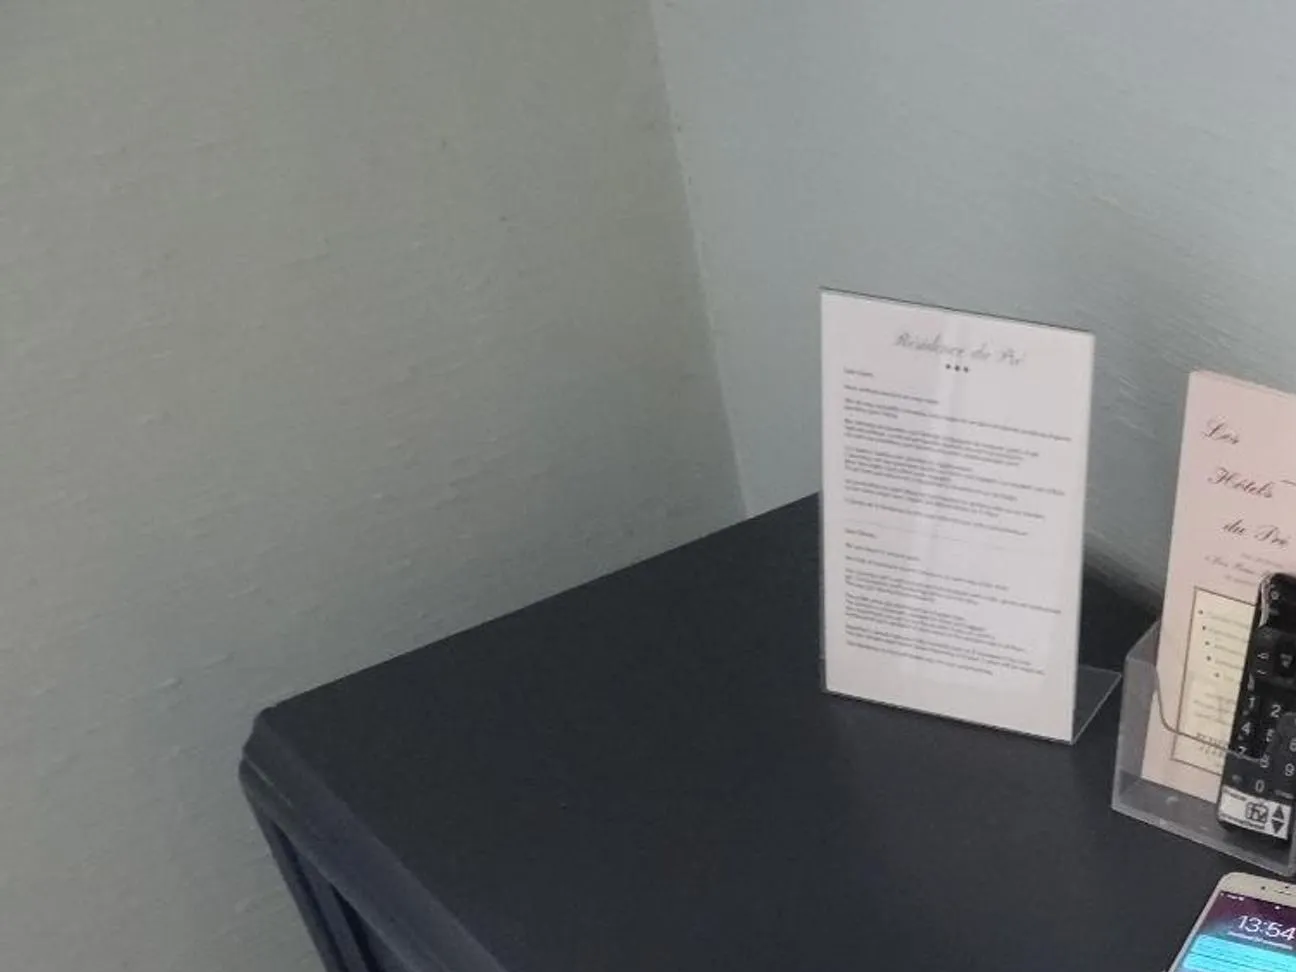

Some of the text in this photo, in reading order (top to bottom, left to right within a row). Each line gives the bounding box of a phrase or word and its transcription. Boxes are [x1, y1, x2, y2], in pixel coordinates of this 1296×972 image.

[1203, 416, 1240, 445] Les
[1207, 466, 1275, 499] Hôtels
[1222, 518, 1290, 545] du Pré
[1270, 704, 1281, 718] 2
[1241, 721, 1251, 735] 4
[1284, 763, 1296, 777] 9
[1255, 779, 1265, 793] 0
[1237, 915, 1296, 941] 13:54
